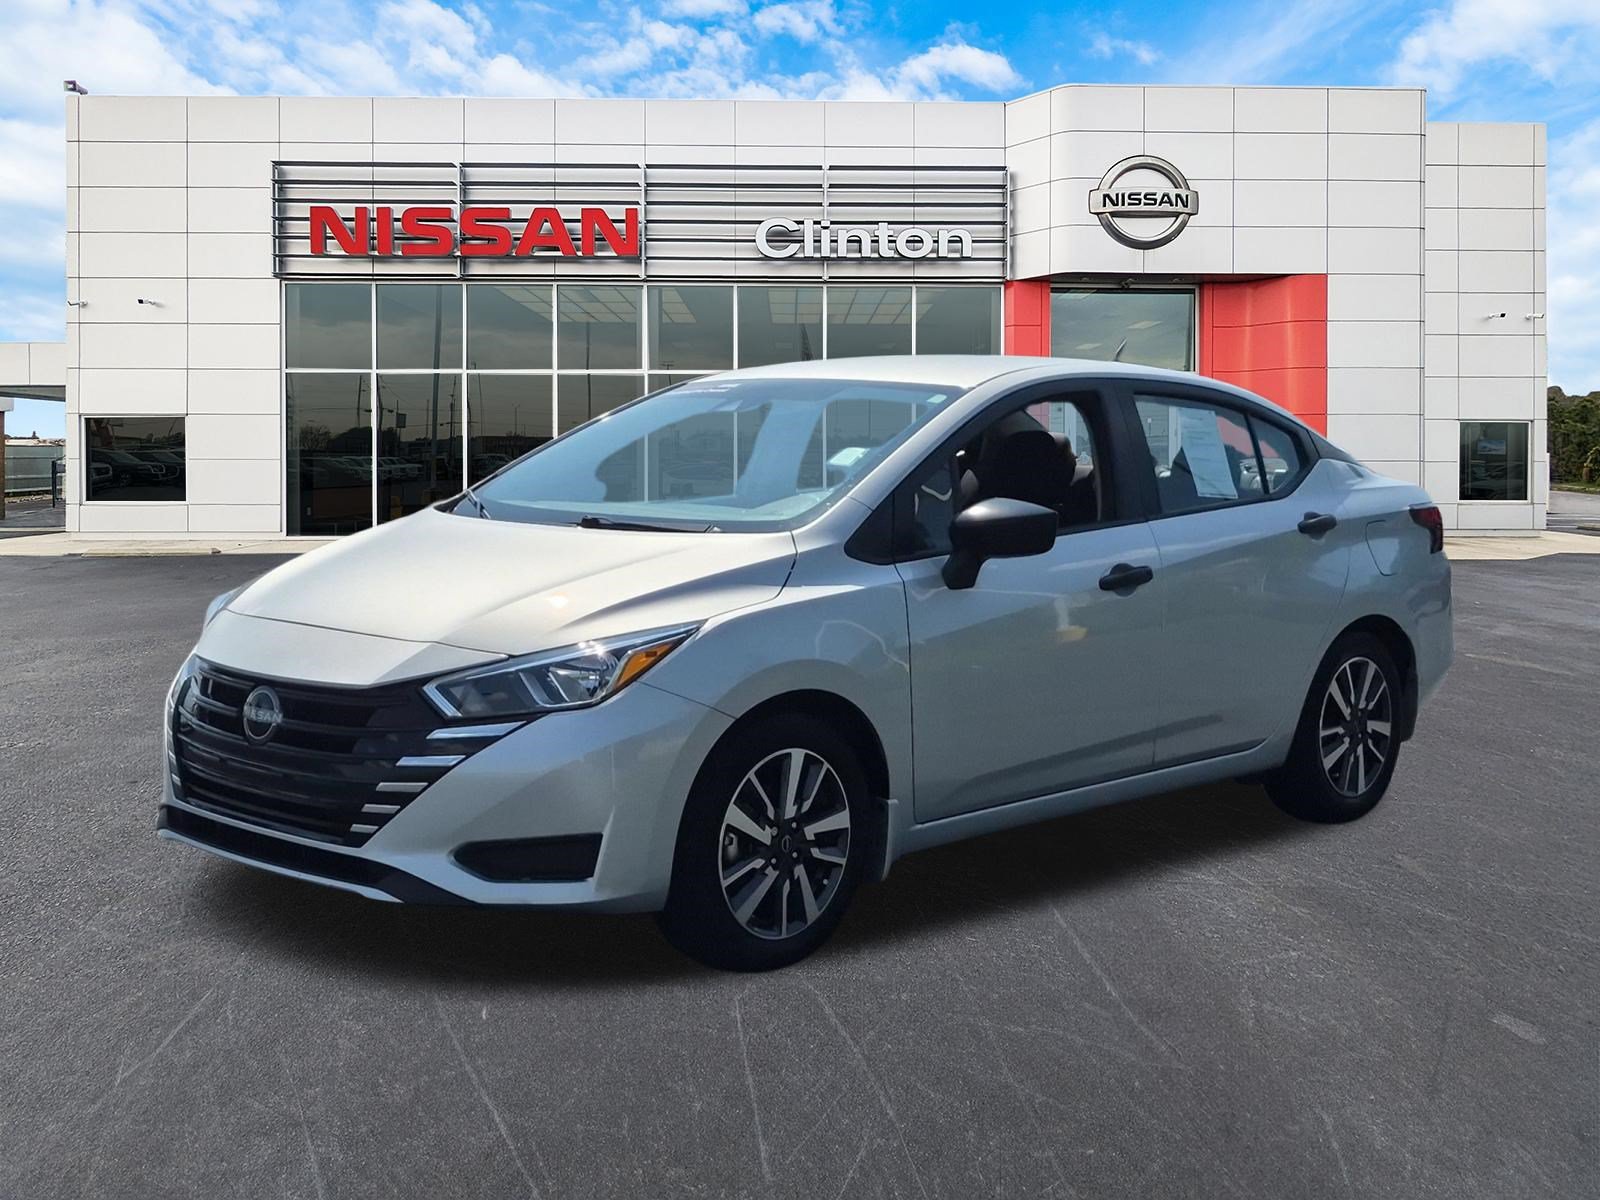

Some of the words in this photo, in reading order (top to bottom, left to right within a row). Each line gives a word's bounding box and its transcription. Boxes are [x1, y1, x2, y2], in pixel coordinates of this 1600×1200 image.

[1102, 192, 1189, 208] NISSAN
[310, 206, 640, 256] NISSAN
[755, 217, 973, 259] Clinton
